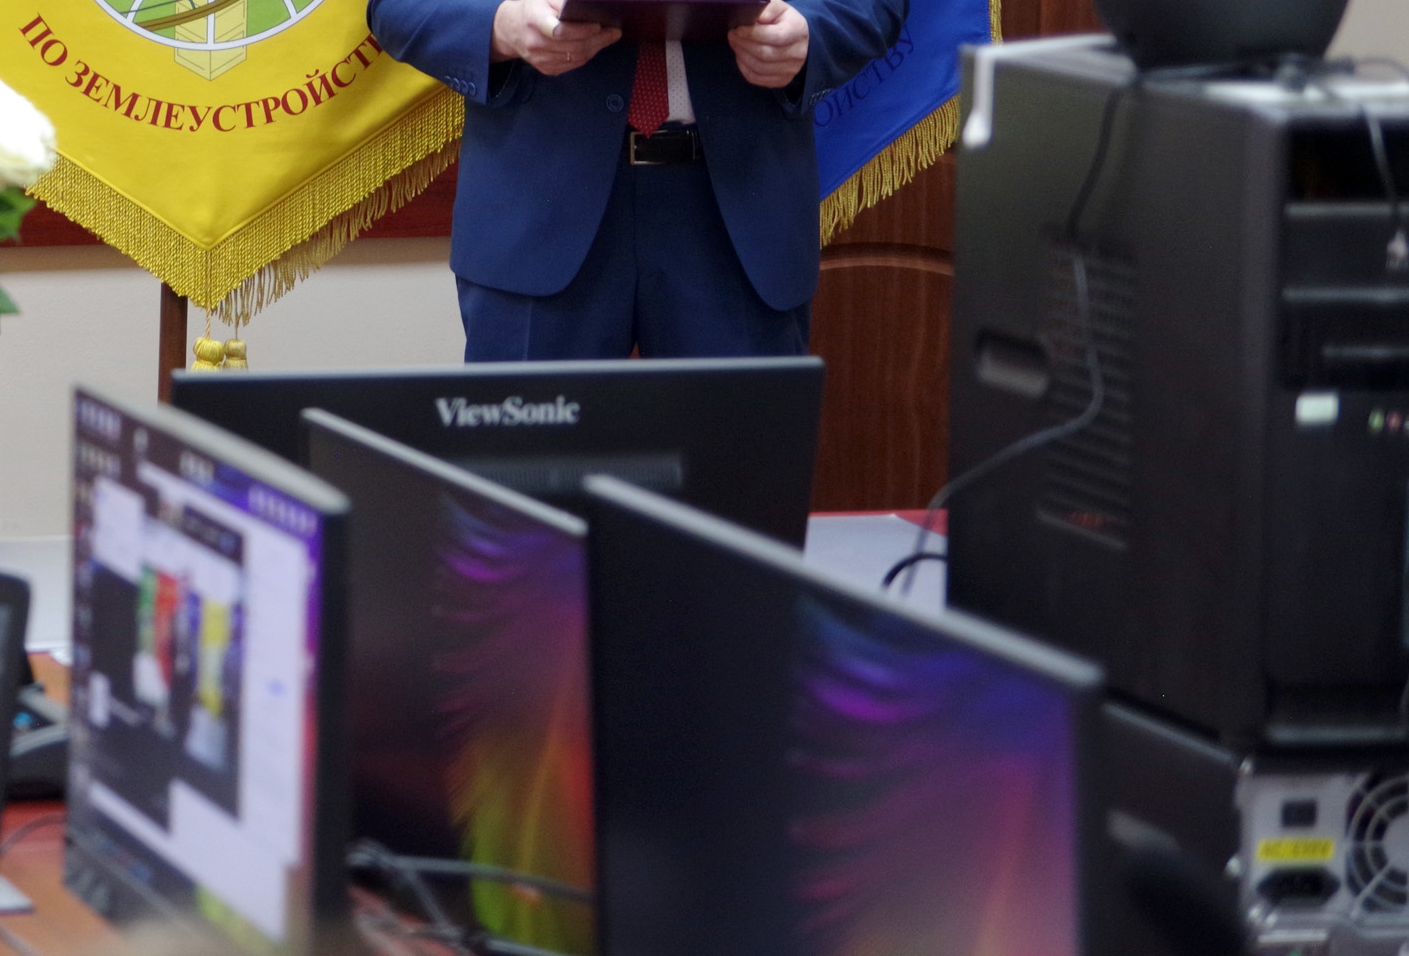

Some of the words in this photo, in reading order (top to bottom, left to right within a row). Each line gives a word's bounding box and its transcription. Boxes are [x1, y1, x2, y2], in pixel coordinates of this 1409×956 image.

[18, 13, 68, 66] ПО
[65, 32, 383, 132] ЗЕМЛЕУСТРОЙСТ
[436, 396, 580, 427] ViewSonic
